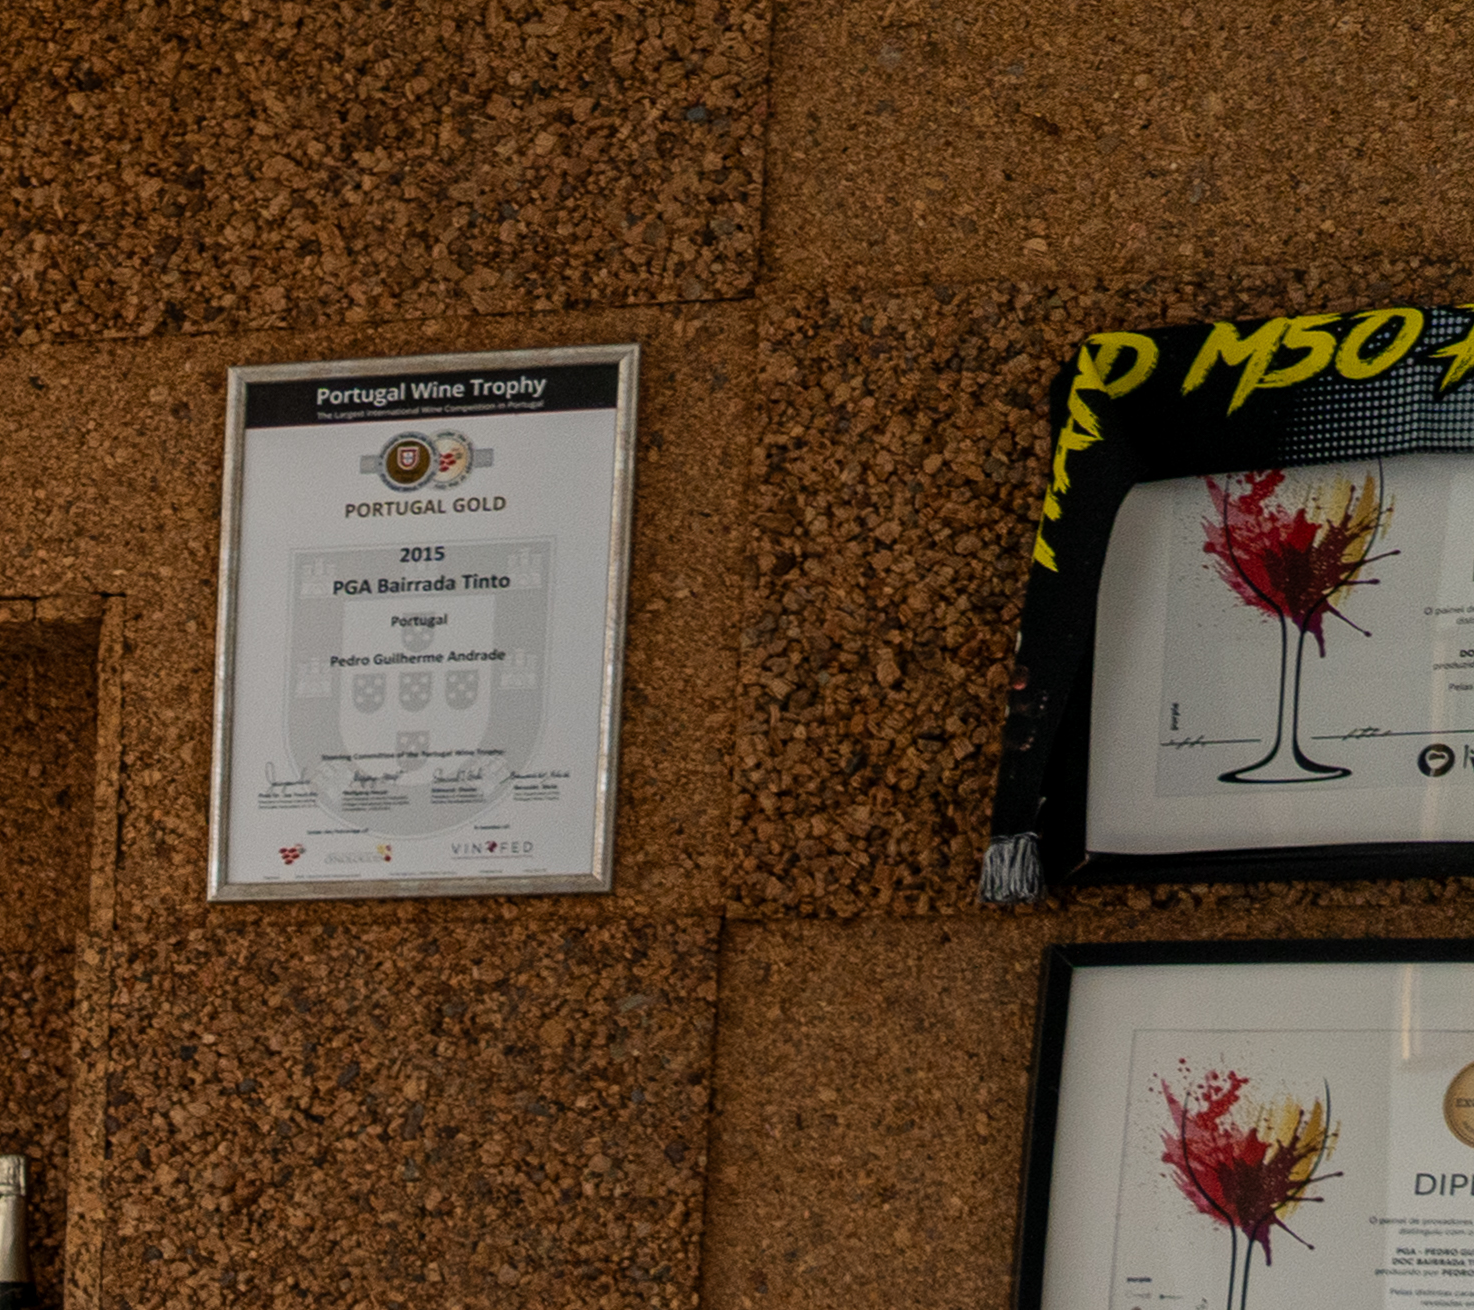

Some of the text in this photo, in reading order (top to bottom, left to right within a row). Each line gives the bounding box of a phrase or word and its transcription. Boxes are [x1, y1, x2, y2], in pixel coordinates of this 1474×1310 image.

[1181, 307, 1424, 418] M50
[316, 376, 547, 407] Portugal Wine Trophy
[345, 496, 507, 519] PORTUGAL GOLD
[399, 546, 446, 563] 2015
[333, 574, 511, 595] PGA Bairrada Tinto
[391, 613, 448, 628] Portugal
[330, 649, 506, 667] Pedro Guilherme Andrade
